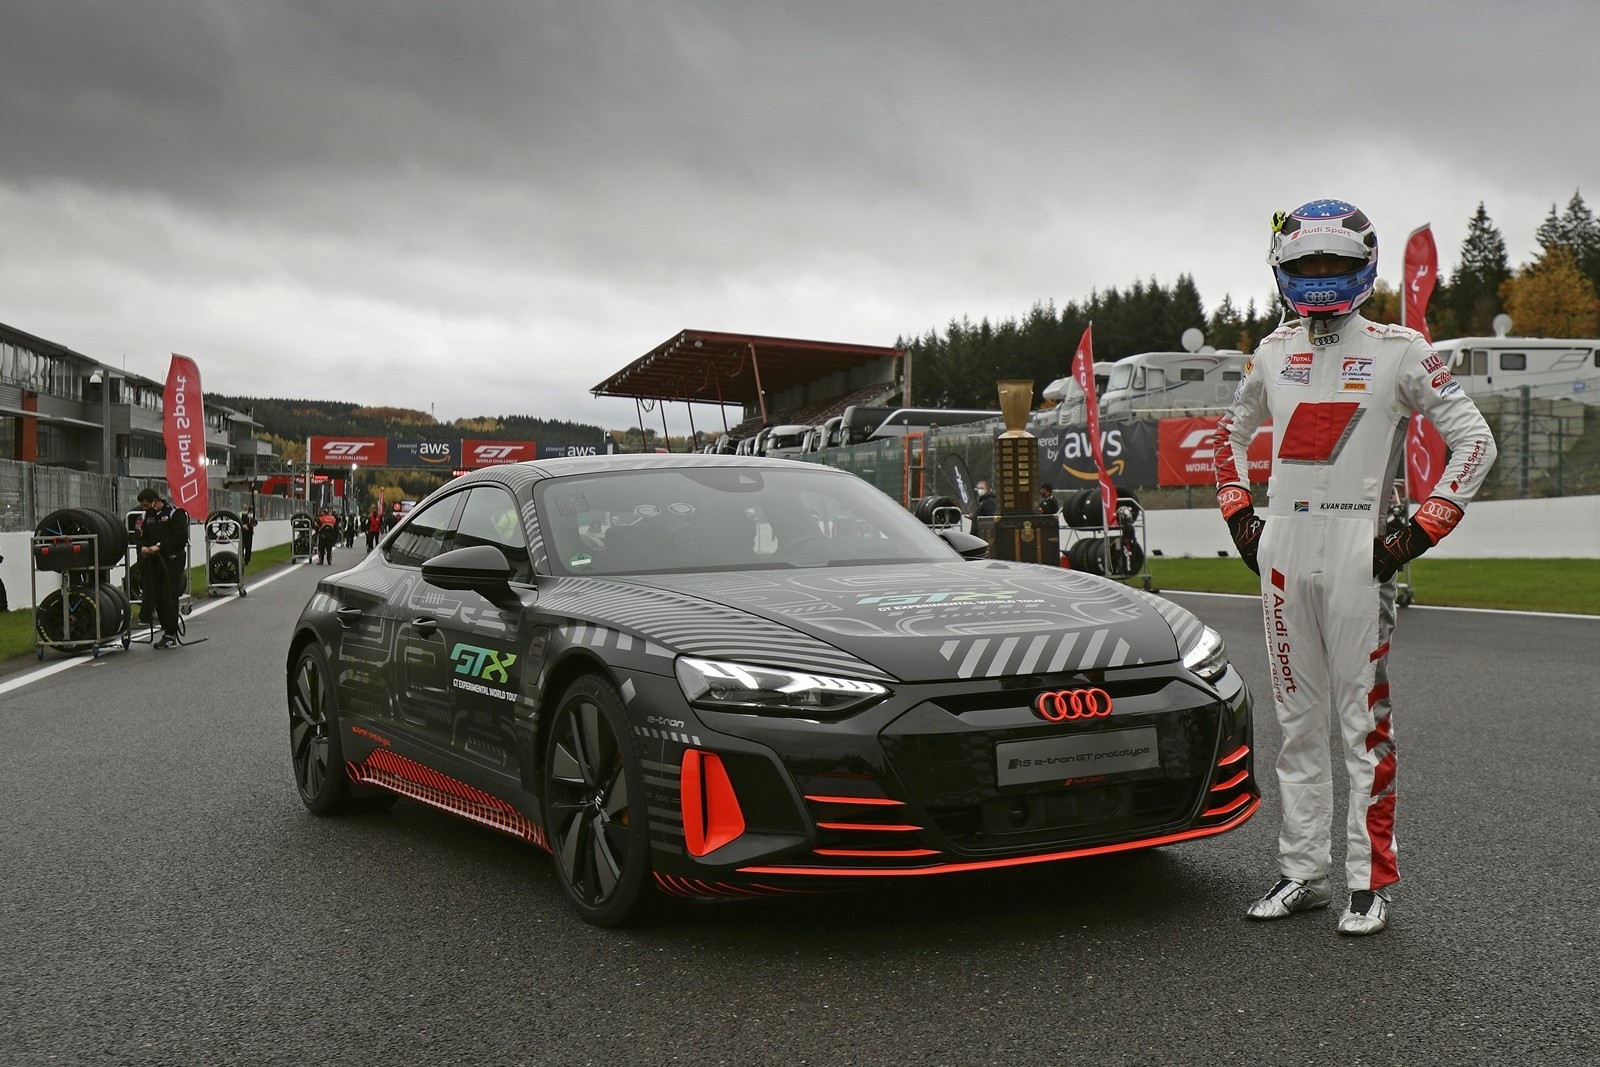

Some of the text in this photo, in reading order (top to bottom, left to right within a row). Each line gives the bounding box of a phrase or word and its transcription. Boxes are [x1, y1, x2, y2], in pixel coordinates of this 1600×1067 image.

[1302, 226, 1352, 236] Audi Sport
[322, 442, 376, 454] GT
[420, 442, 450, 455] aws
[474, 445, 524, 458] GT
[568, 446, 596, 456] aws
[1047, 449, 1059, 461] by
[1456, 440, 1482, 482] Audi Sport
[894, 601, 976, 610] EXPERIMENTAL
[1263, 593, 1283, 703] customer racing
[1274, 593, 1297, 693] Audi Sport
[453, 678, 458, 687] GT
[459, 680, 489, 695] EXPERIMENTAL
[489, 688, 506, 700] WORLD
[648, 716, 684, 728] e-tron
[1035, 757, 1074, 766] e-tron
[1076, 753, 1093, 761] GT
[1095, 747, 1150, 761] prototype
